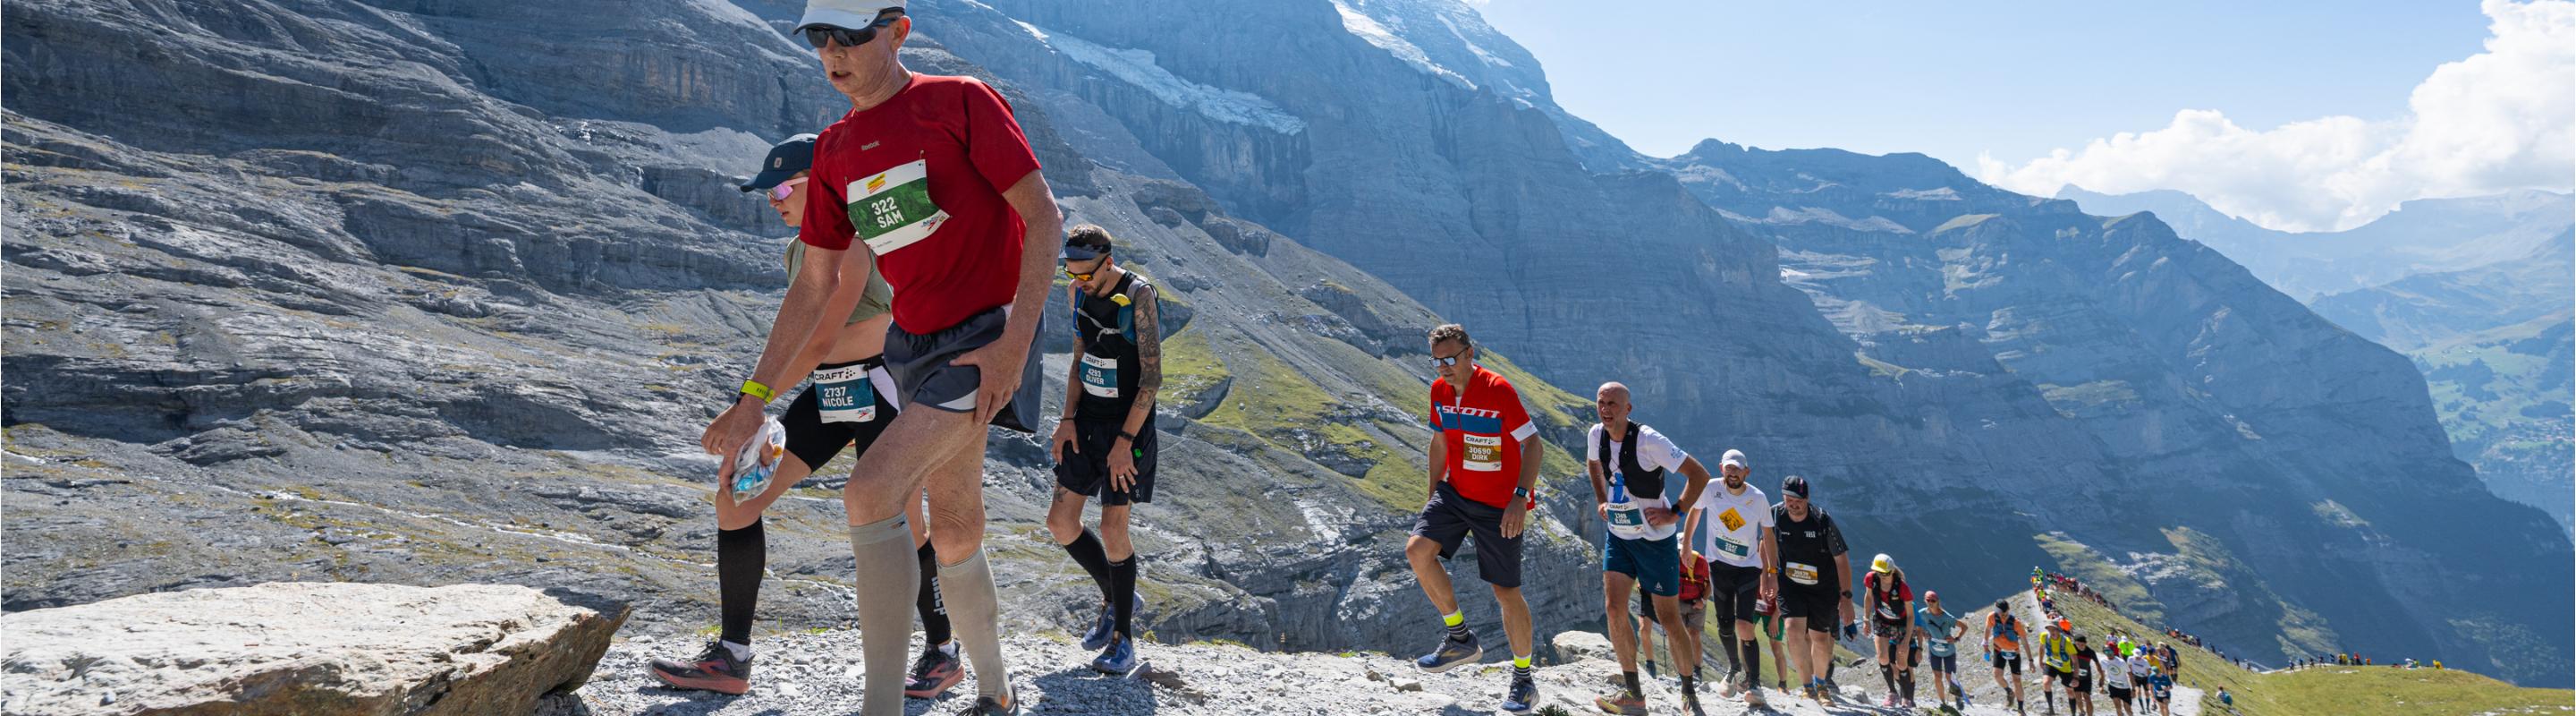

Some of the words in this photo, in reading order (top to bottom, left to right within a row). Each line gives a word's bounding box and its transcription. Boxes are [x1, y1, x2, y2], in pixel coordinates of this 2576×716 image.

[871, 196, 897, 216] 322
[877, 209, 904, 228] SAM
[815, 371, 844, 381] CRAFT
[1085, 374, 1105, 385] OLIVER
[824, 387, 846, 397] 2737
[822, 396, 854, 407] NICOLE
[1442, 405, 1500, 419] SCOTT
